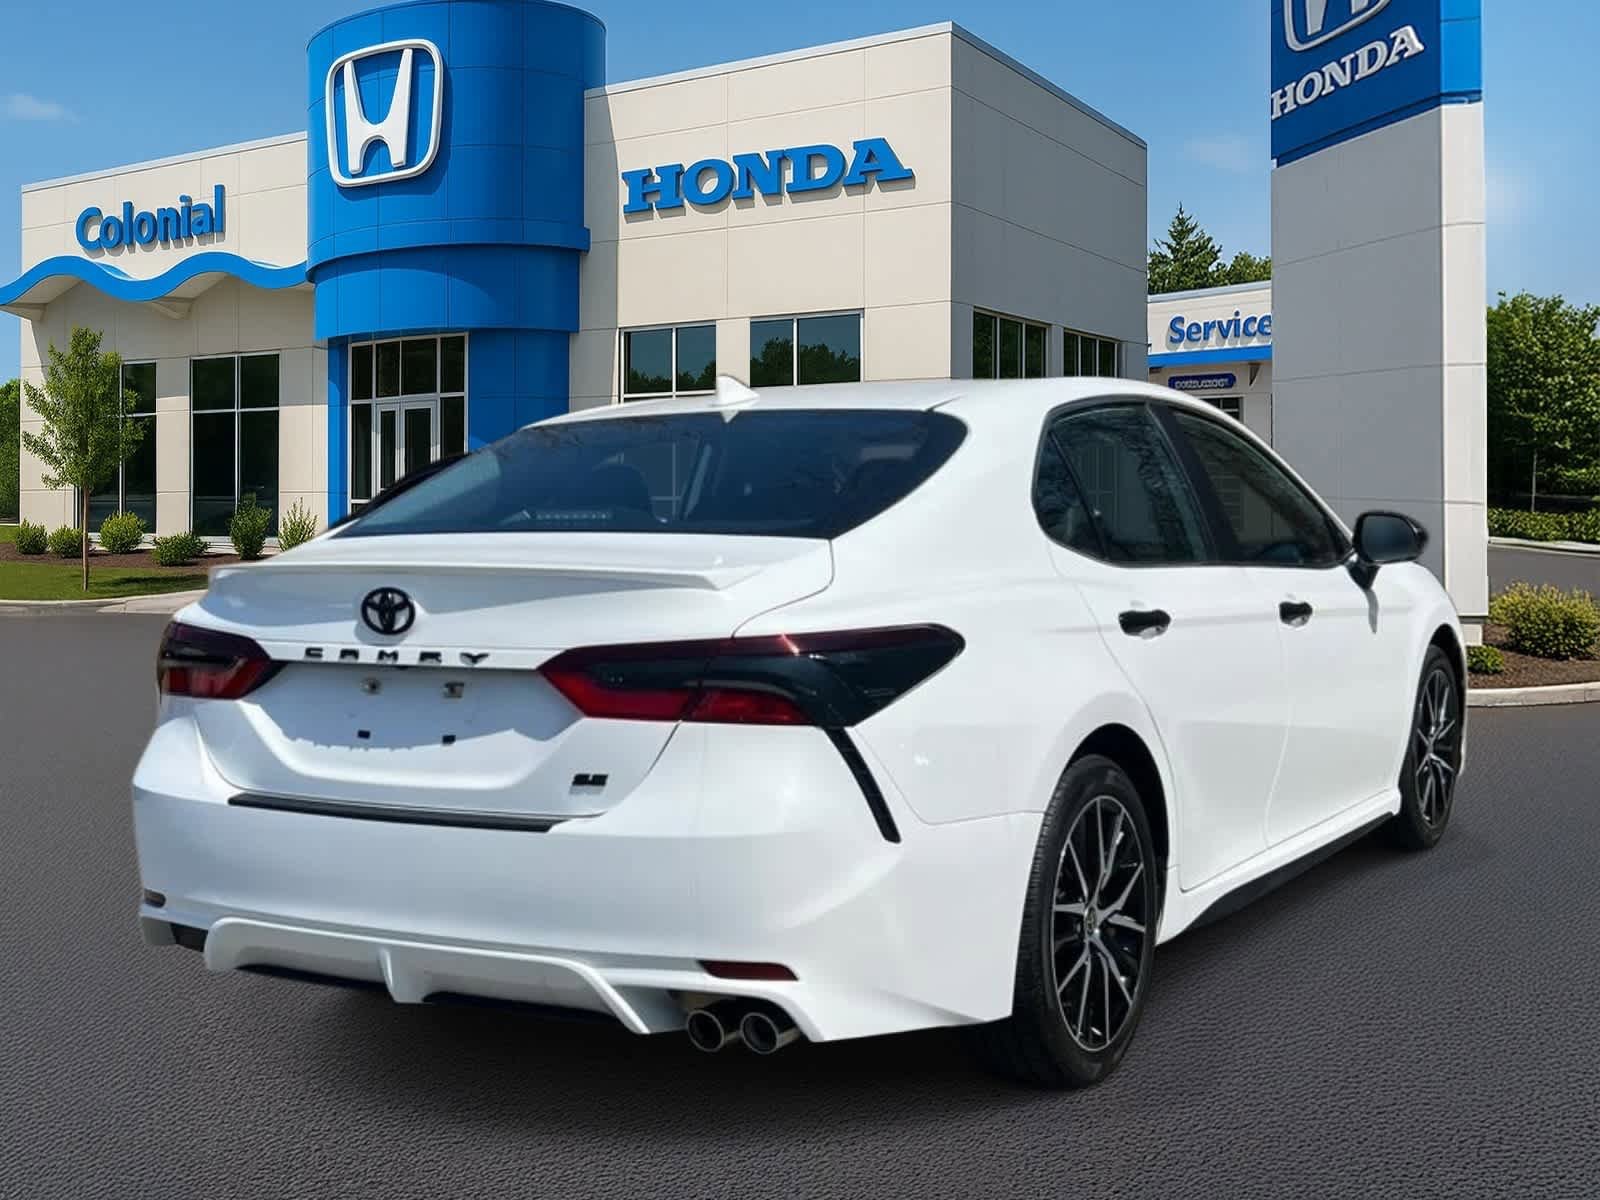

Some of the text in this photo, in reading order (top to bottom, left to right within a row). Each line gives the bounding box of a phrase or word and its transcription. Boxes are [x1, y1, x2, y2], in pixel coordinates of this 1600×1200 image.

[1271, 25, 1424, 120] HONDA
[621, 137, 914, 214] HONDA
[76, 184, 225, 251] Colonial
[1169, 310, 1271, 344] Service
[305, 647, 490, 664] CAMRY
